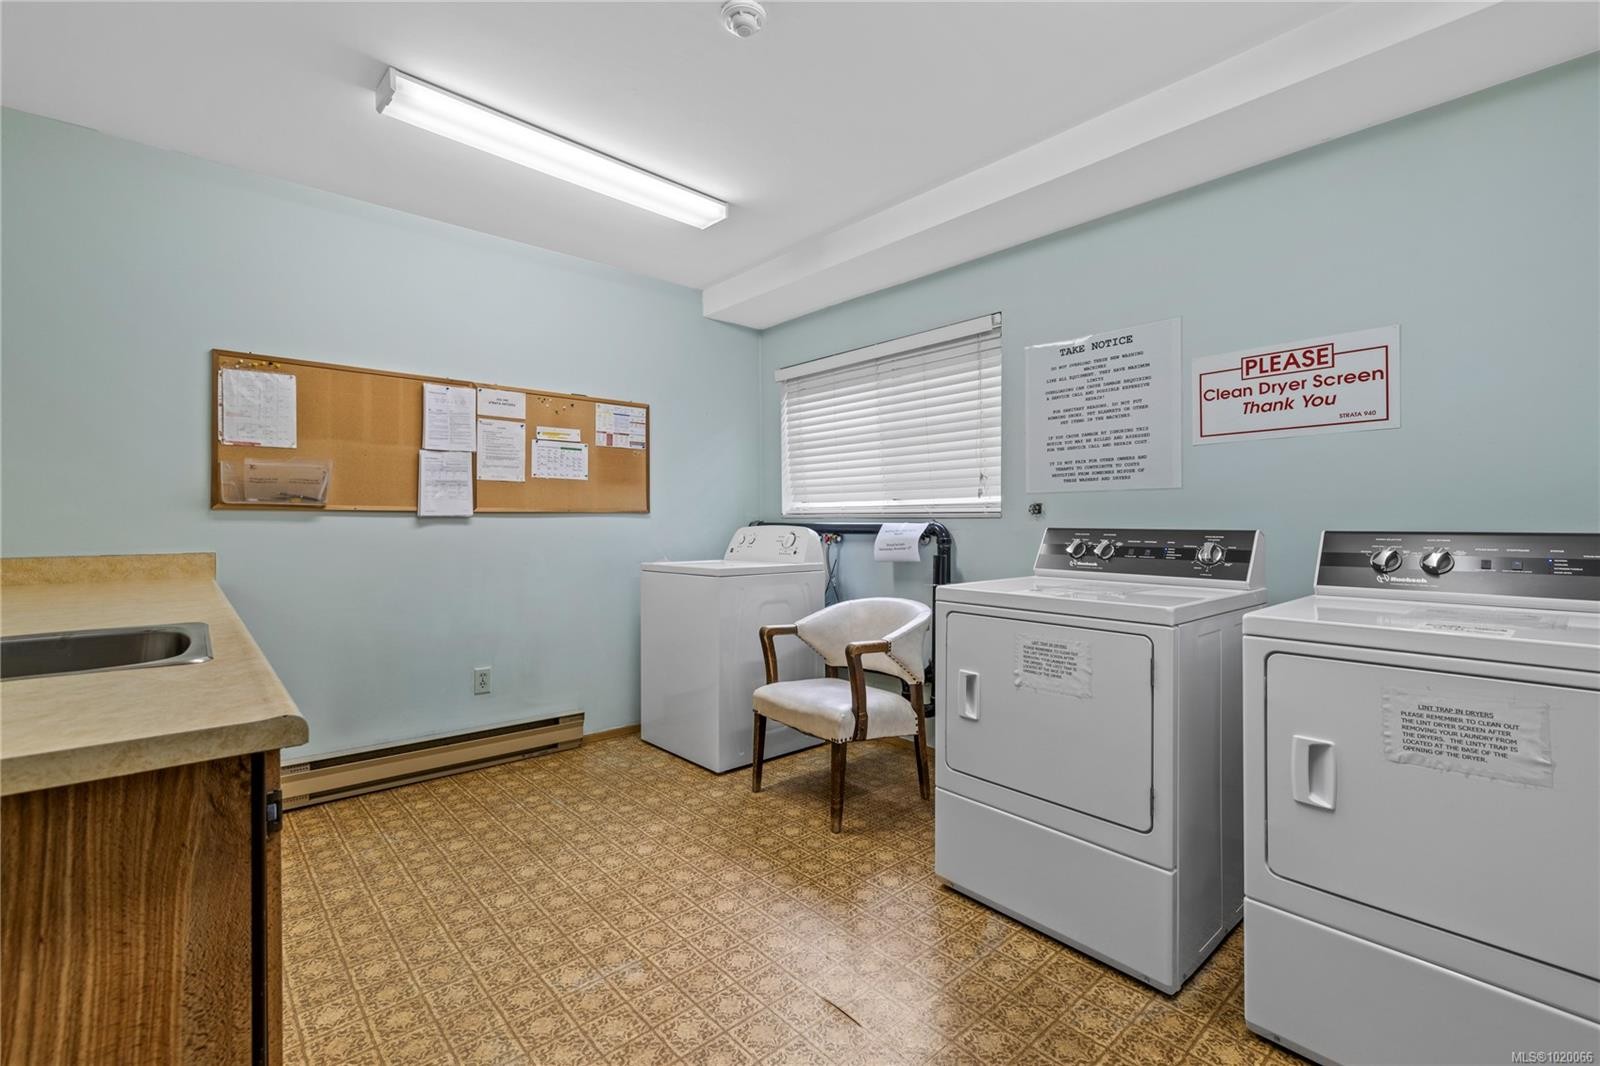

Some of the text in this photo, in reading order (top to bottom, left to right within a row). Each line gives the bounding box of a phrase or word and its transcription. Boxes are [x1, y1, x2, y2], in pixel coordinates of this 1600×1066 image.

[1059, 335, 1133, 356] TAKE NOTICE
[1084, 363, 1106, 371] MACHINES
[1244, 347, 1329, 376] PLEASE
[1097, 386, 1120, 394] POSSIBLE
[1123, 382, 1150, 390] EXPENSIVE
[1203, 370, 1385, 402] Clean Dryer Screen
[1087, 402, 1110, 410] REASONS,
[1242, 395, 1337, 415] Thank You
[1338, 412, 1362, 420] STRATA
[1418, 704, 1434, 712] LINT
[1436, 706, 1453, 714] TRAP
[1465, 709, 1493, 719] DRYERS
[1400, 710, 1424, 718] PLEASE
[1426, 713, 1463, 723] REMEMBER
[1478, 719, 1501, 728] CLEAN
[1503, 723, 1519, 731] OUT
[1401, 724, 1517, 746] REMOVING YOUR LAUNDRY FROM
[1433, 721, 1456, 729] DRYER
[1458, 724, 1485, 733] SCREEN
[1488, 728, 1511, 737] AFTER
[1402, 738, 1432, 747] LOCATED
[1461, 746, 1478, 755] BASE
[1493, 751, 1508, 759] THE
[1403, 744, 1433, 754] OPENING
[1450, 737, 1463, 745] THE
[1465, 739, 1486, 748] LINTY
[1489, 743, 1508, 751] TRAP
